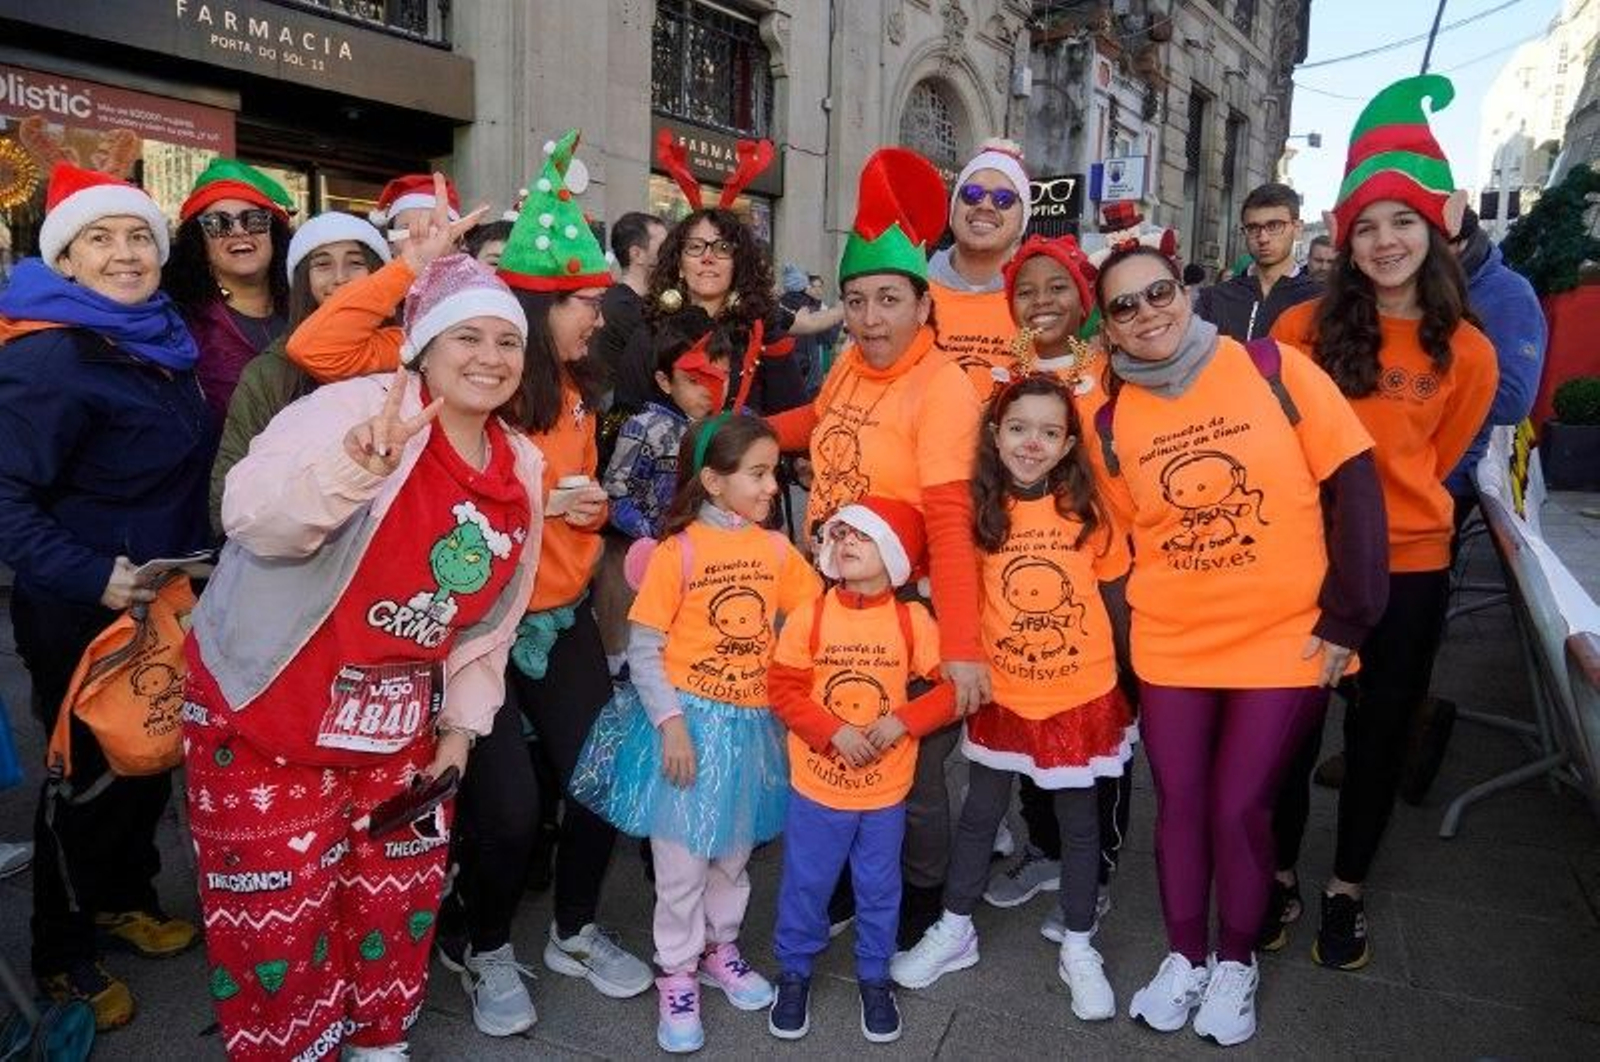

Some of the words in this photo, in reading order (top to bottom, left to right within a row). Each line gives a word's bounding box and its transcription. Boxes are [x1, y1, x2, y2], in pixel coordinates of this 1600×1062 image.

[176, 0, 353, 61] FARMACIA
[210, 34, 251, 54] PORTA
[259, 46, 276, 60] DO
[283, 52, 304, 67] SOL
[334, 699, 421, 735] 4840
